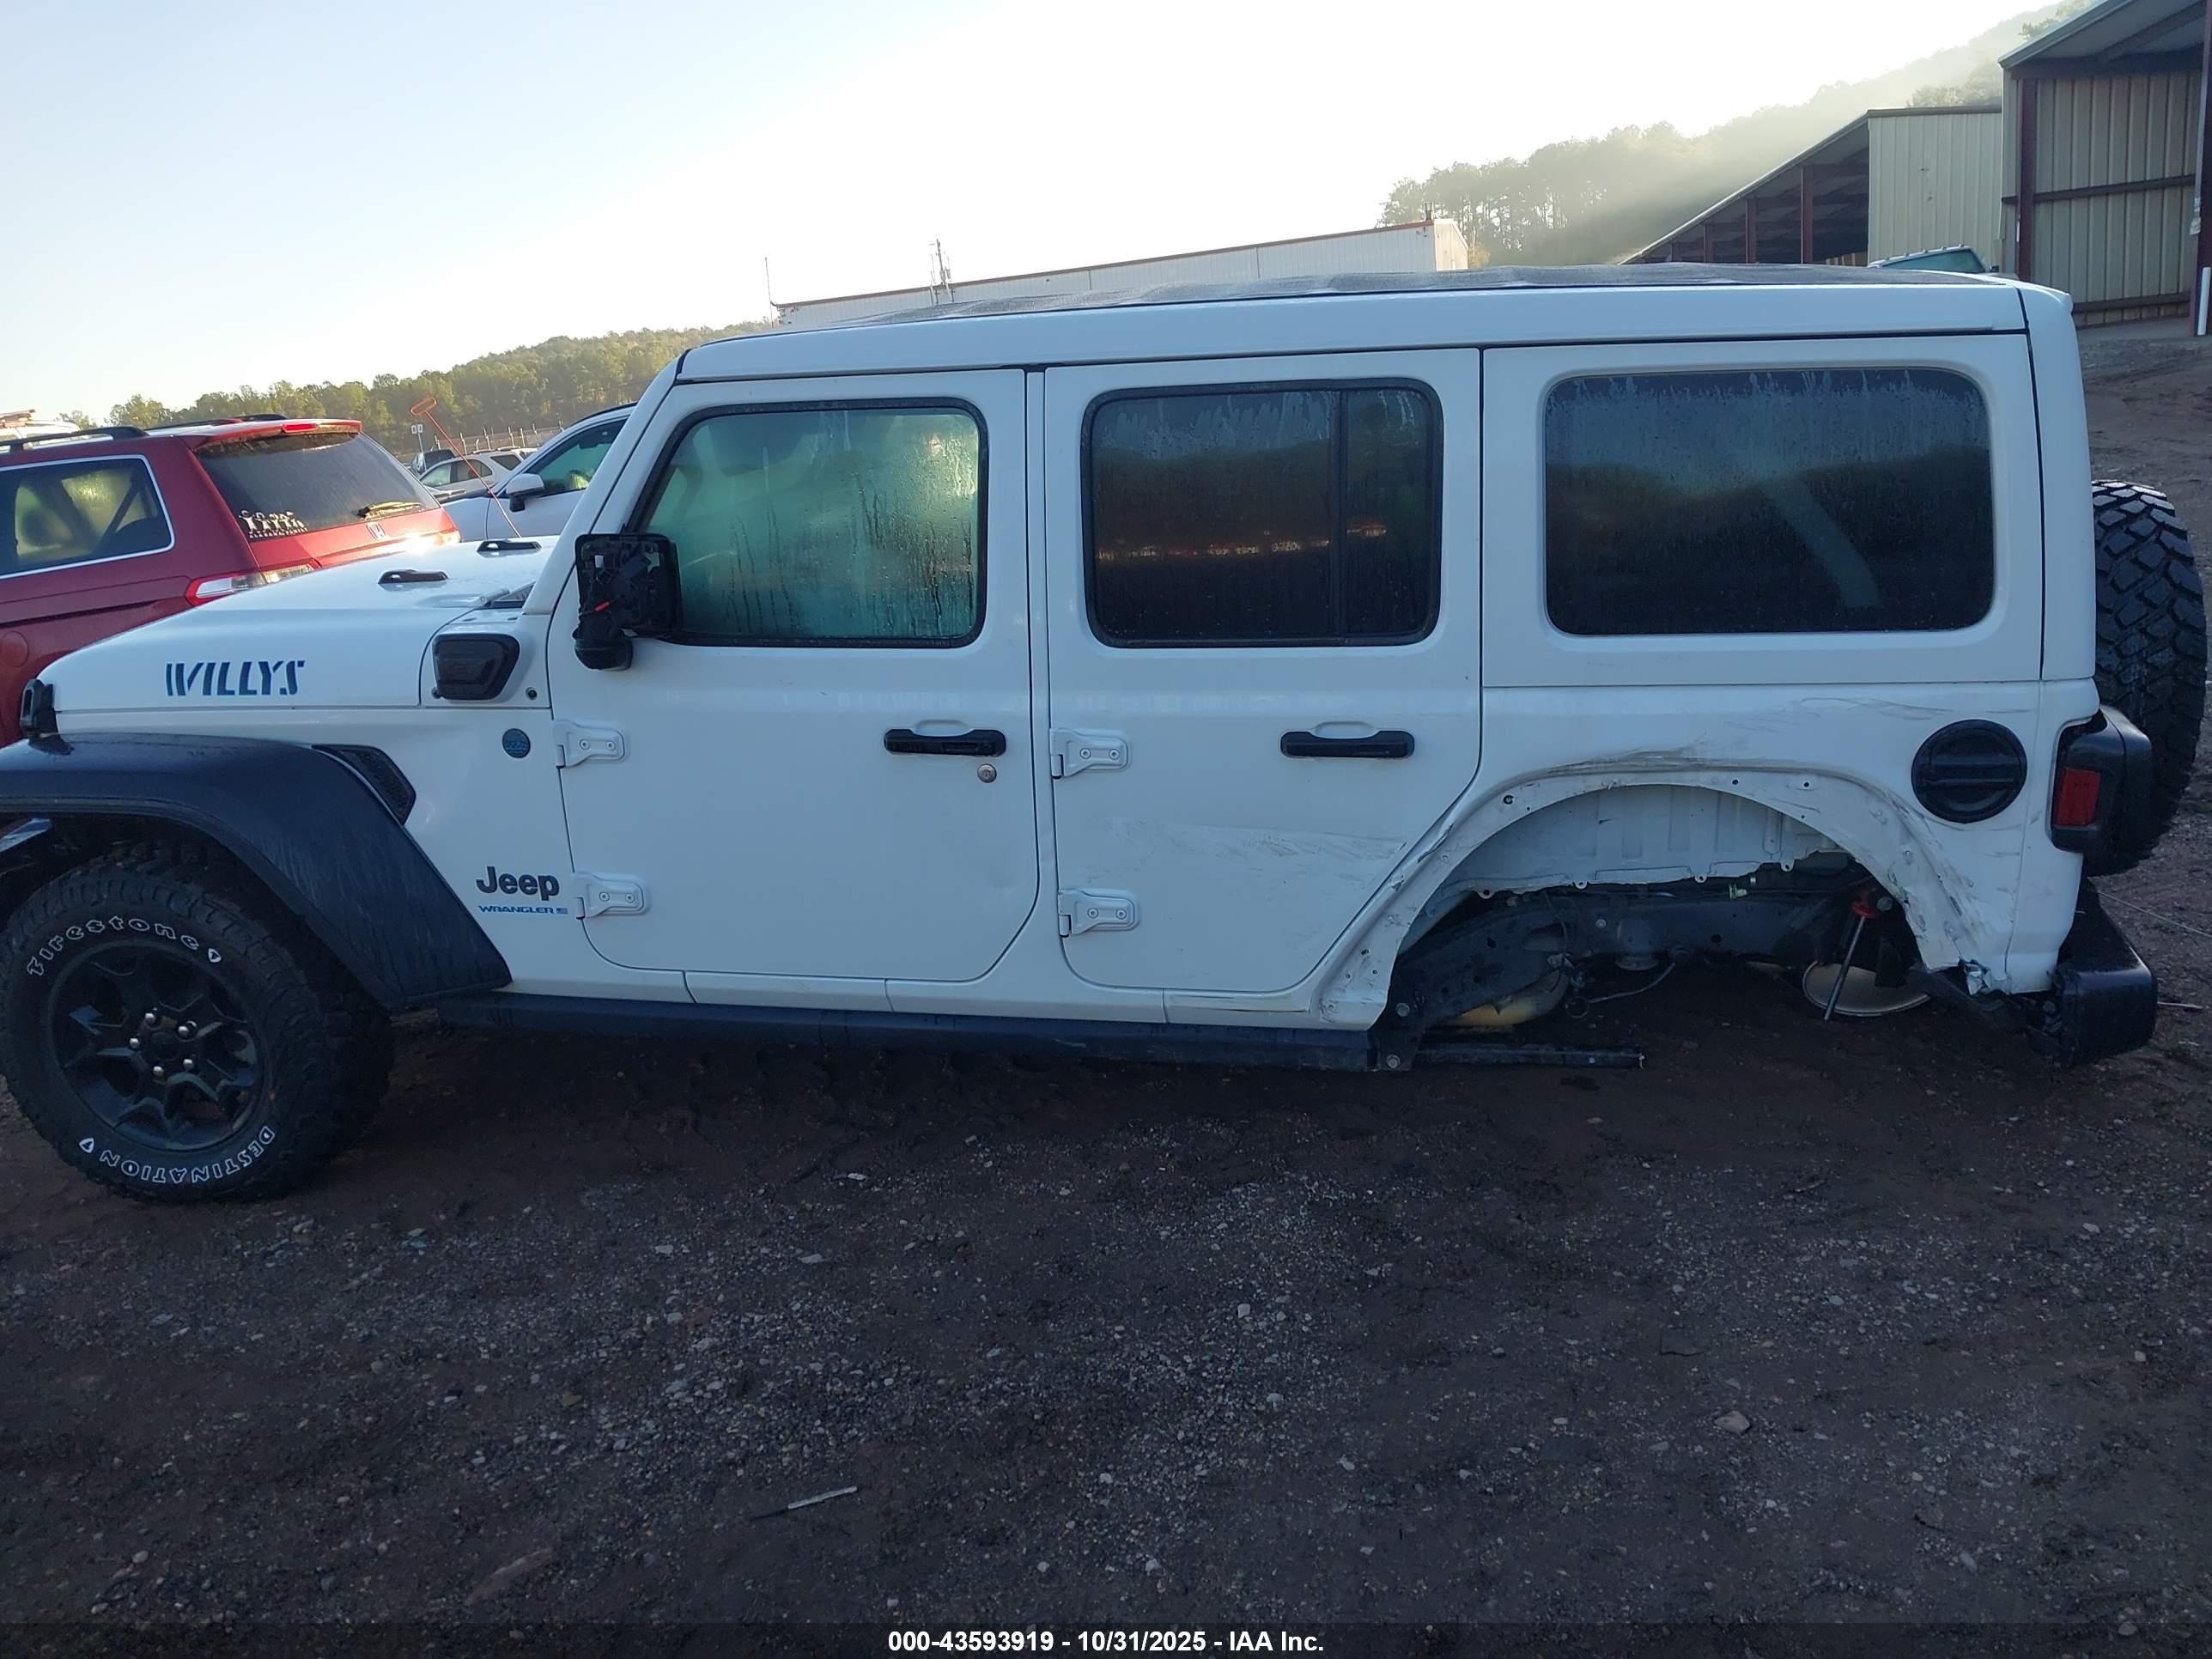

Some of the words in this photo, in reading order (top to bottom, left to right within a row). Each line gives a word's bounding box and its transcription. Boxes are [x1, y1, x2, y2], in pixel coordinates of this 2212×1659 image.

[166, 660, 306, 696] WILLYS
[476, 866, 560, 901] Jeep
[477, 905, 555, 915] WRANGLER
[27, 915, 200, 977] Firestone
[99, 1126, 276, 1183] DESTINATION
